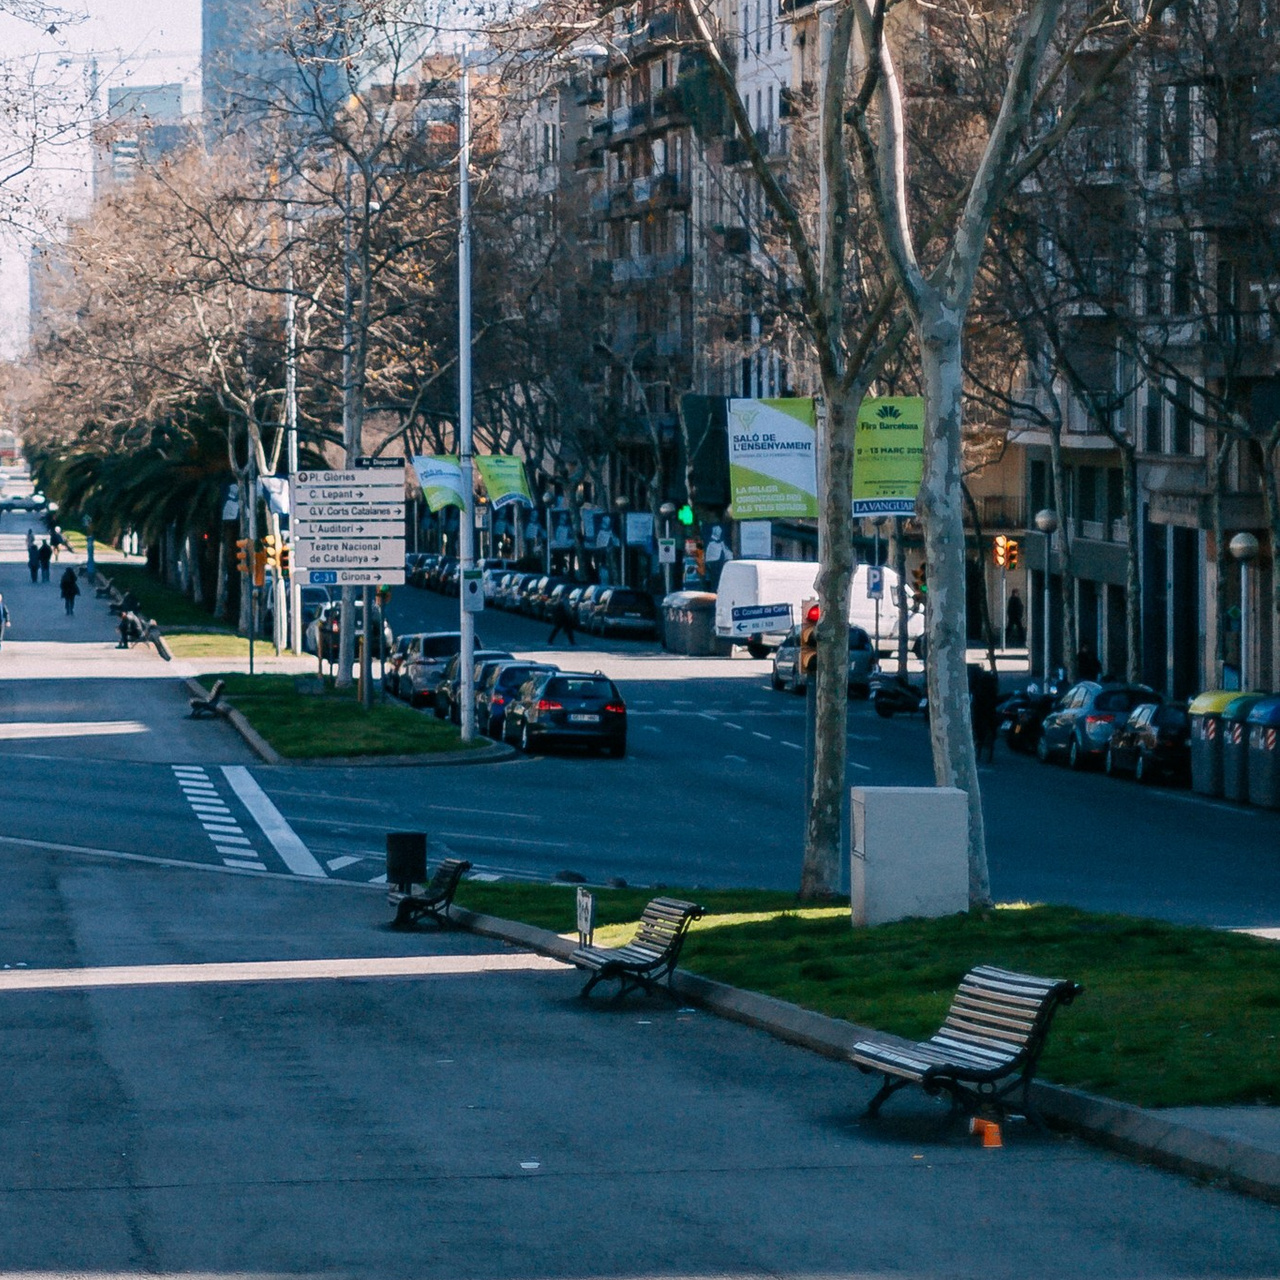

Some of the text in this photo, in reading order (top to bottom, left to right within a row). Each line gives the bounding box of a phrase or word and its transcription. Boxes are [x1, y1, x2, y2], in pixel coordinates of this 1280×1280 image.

[879, 422, 918, 430] Barcelona
[733, 433, 776, 442] SALÓ DE
[733, 441, 811, 451] L'ENSENYAMENT
[373, 458, 399, 466] Diagonal
[309, 472, 356, 482] Pl. Glòries
[309, 490, 353, 500] C. Lepant
[856, 501, 914, 512] LA VANGUAR
[327, 507, 349, 516] Corts
[351, 507, 391, 516] Catalanes
[309, 524, 354, 533] L'Auditori
[310, 542, 381, 551] Teatre Nacional
[310, 554, 368, 564] de Catalunya
[341, 572, 371, 581] Girona
[870, 570, 880, 588] P
